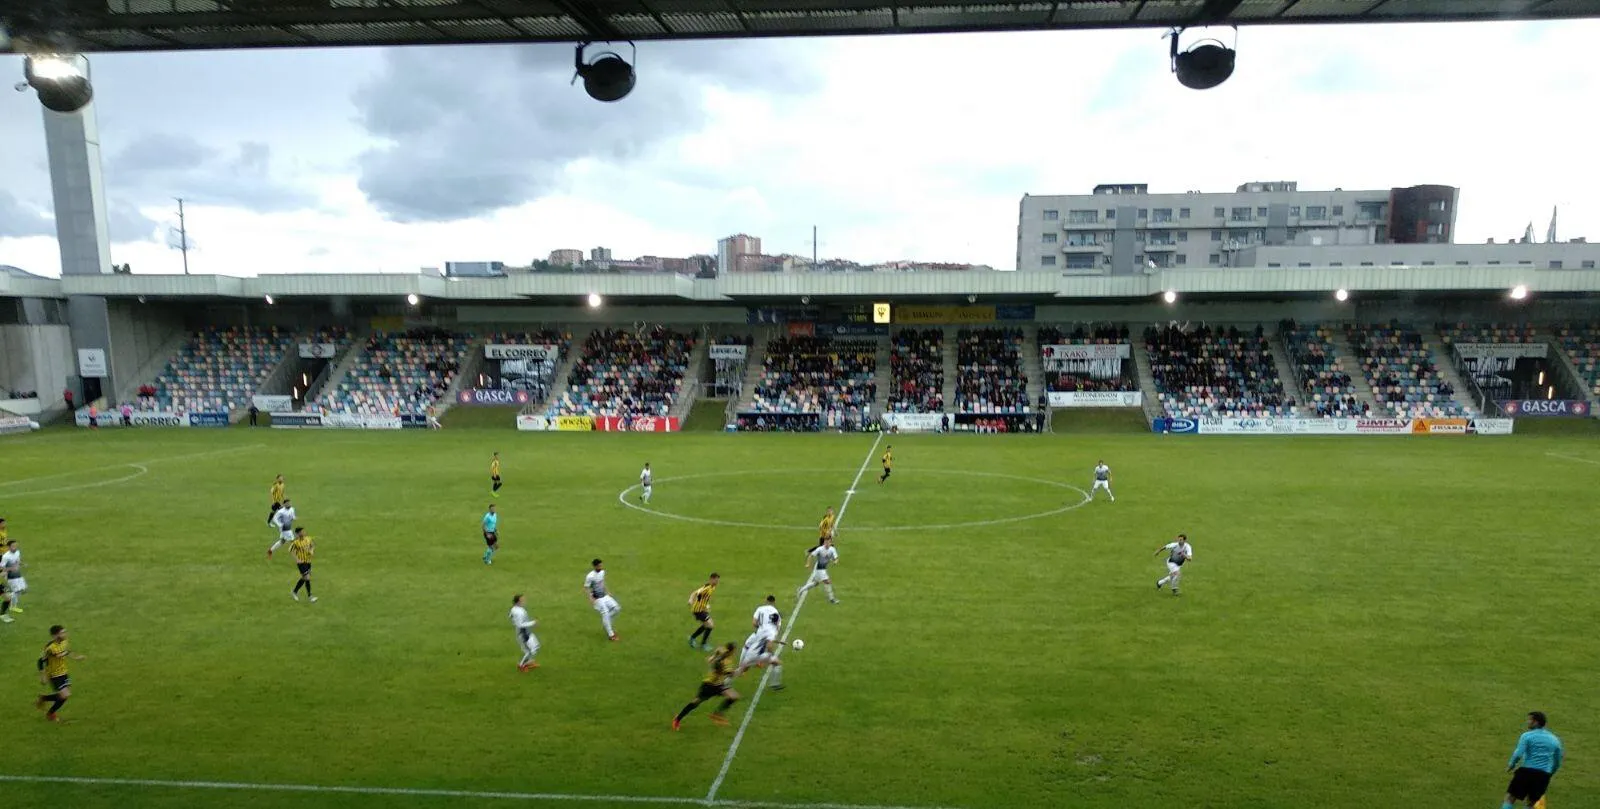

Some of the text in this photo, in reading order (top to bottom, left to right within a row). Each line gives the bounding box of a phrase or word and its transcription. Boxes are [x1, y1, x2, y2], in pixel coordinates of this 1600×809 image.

[491, 348, 548, 358] EL CORREO
[475, 390, 514, 402] GASCA
[1522, 400, 1566, 412] GASCA
[134, 416, 181, 427] CORREO
[1357, 418, 1410, 428] SIMPLY
